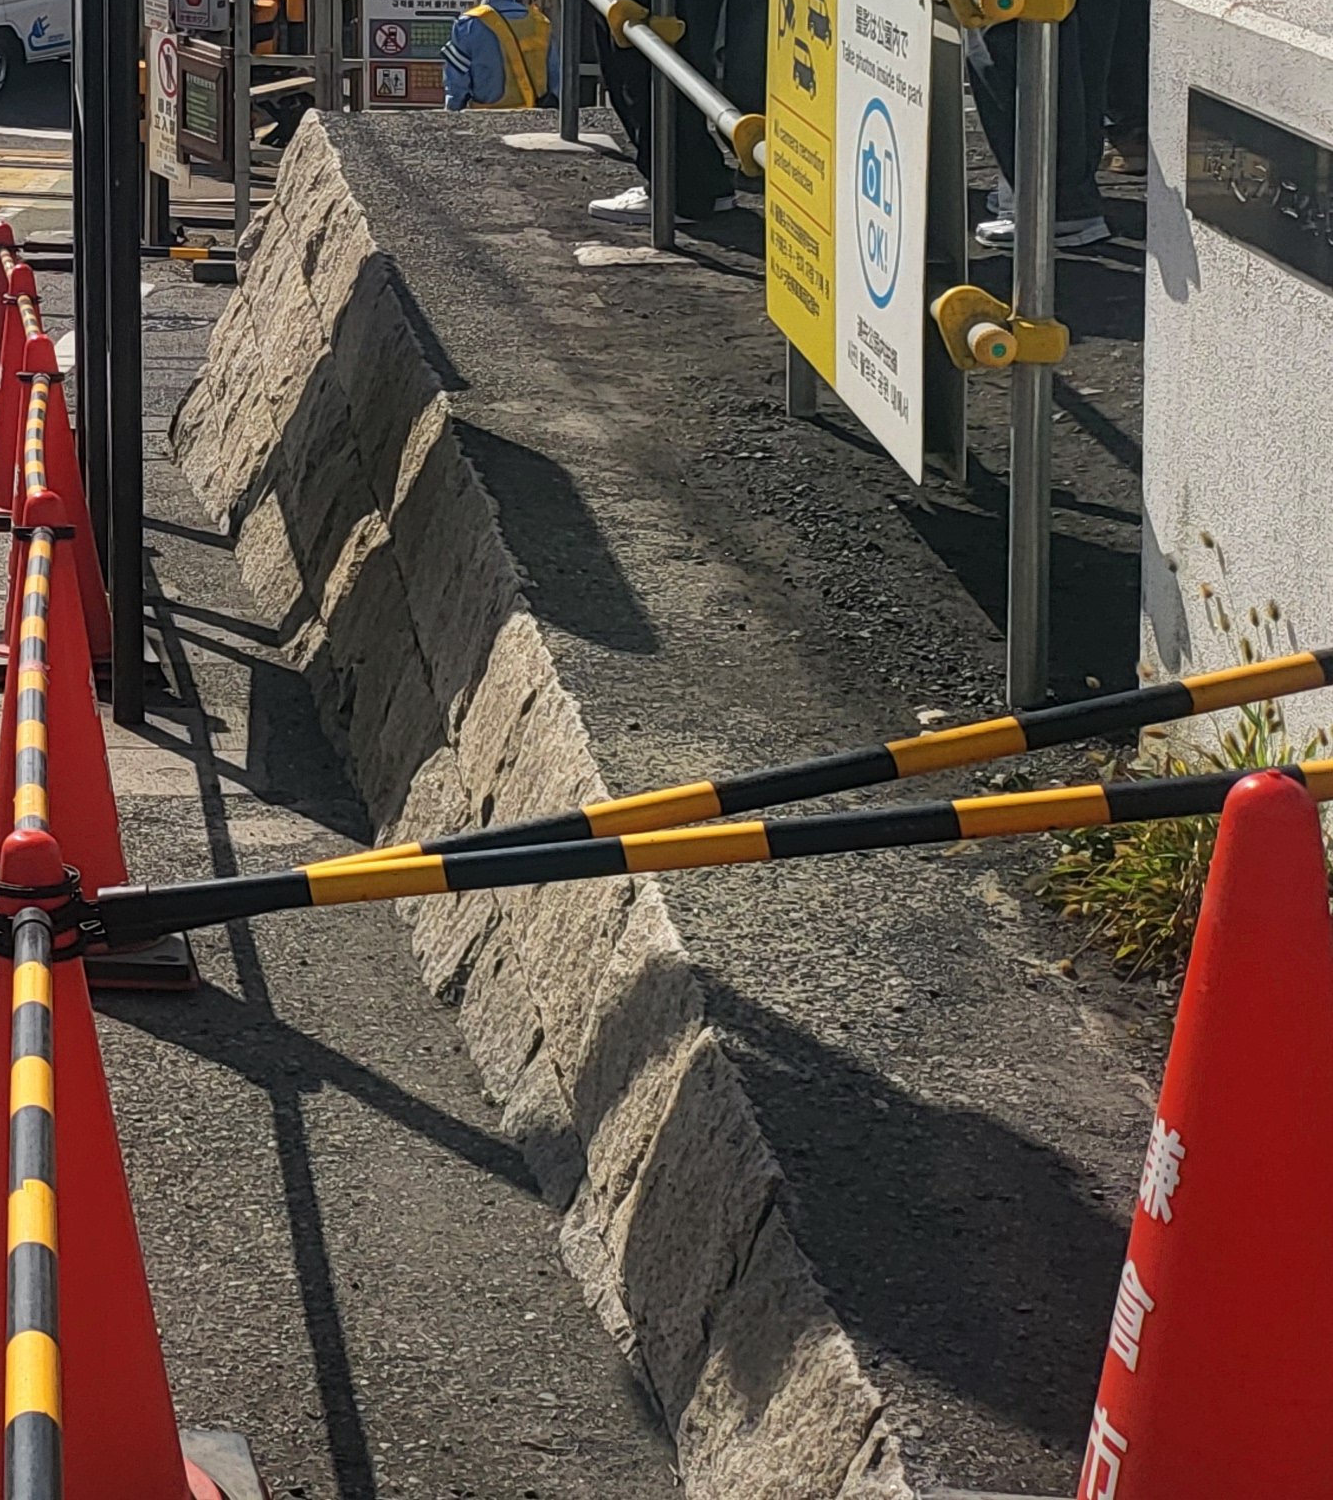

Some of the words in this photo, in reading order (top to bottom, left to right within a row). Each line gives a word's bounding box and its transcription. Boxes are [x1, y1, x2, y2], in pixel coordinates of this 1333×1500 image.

[841, 40, 855, 66] Take
[855, 49, 875, 80] photos
[875, 60, 895, 91] inside
[895, 70, 906, 98] the
[907, 83, 923, 108] park
[154, 113, 175, 135] 立入禁
[867, 219, 889, 275] OK!
